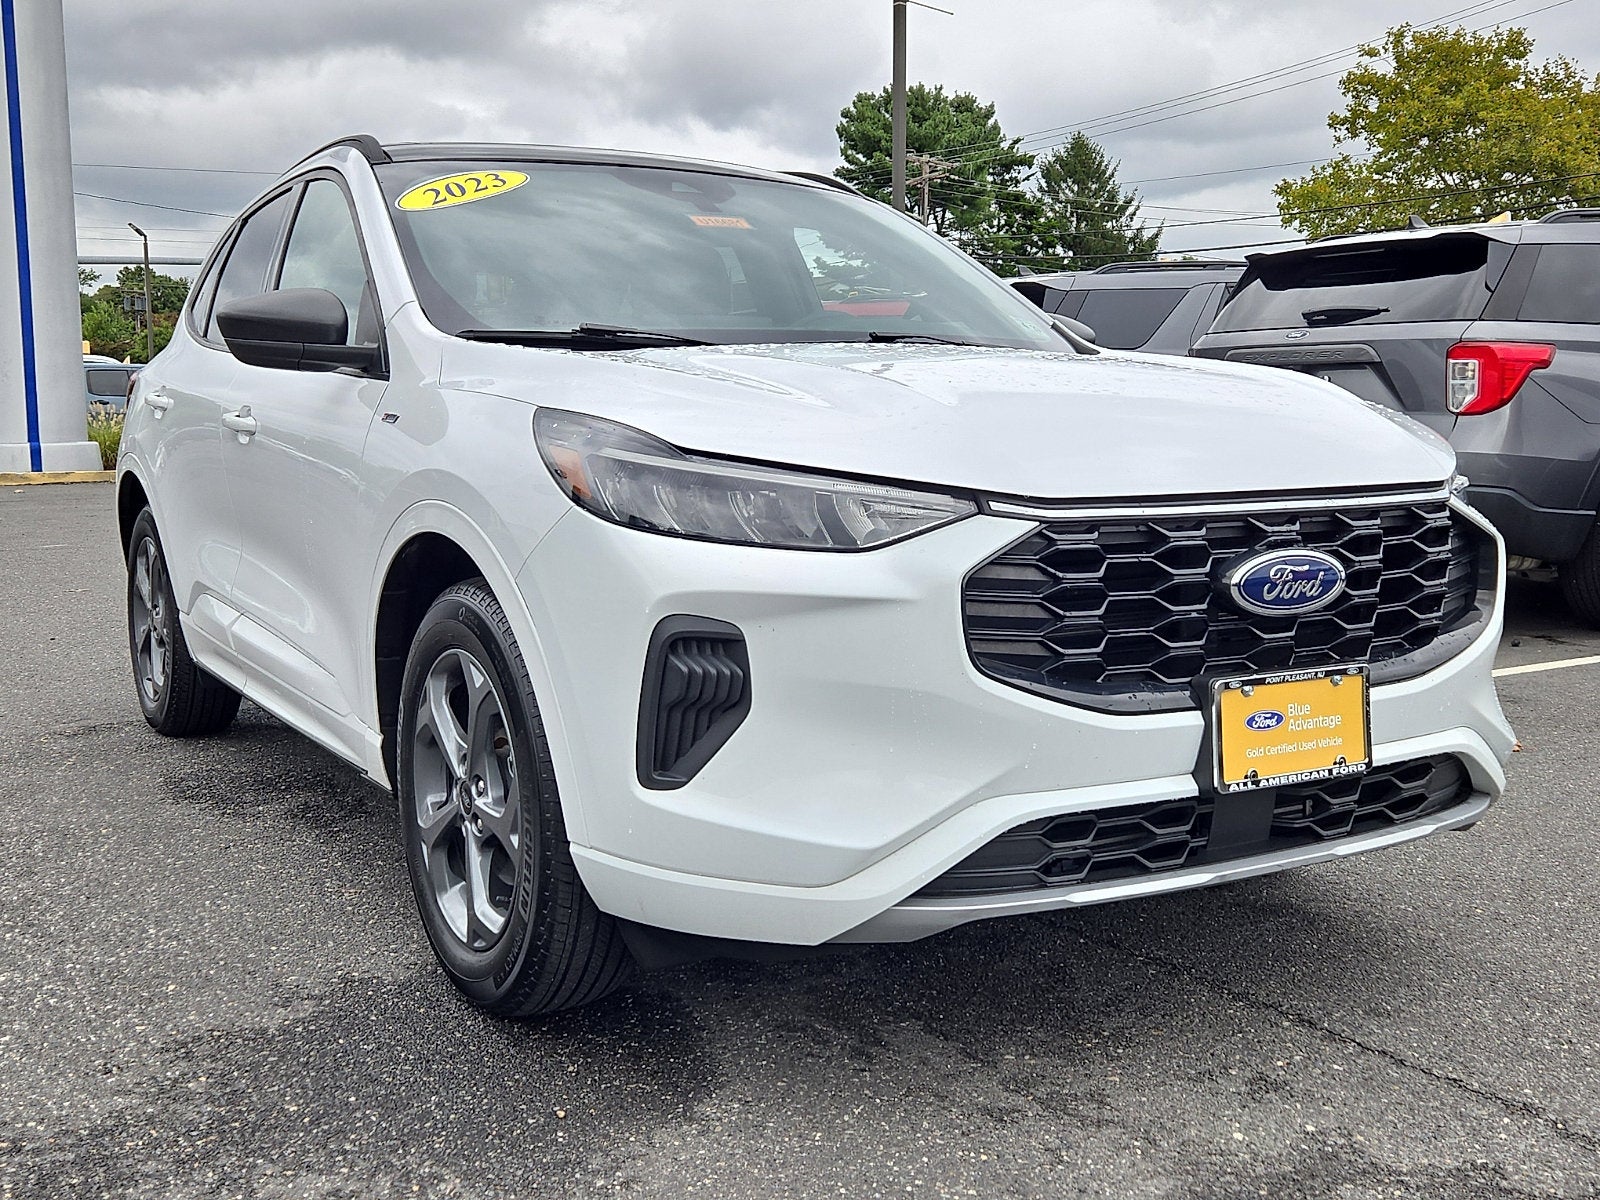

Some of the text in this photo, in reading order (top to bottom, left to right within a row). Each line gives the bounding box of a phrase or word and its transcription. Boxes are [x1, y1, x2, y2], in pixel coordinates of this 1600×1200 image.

[423, 173, 507, 206] 2023
[1243, 350, 1345, 362] EXPLORER
[1262, 564, 1325, 601] Ford
[1265, 676, 1284, 684] POINT
[1287, 703, 1311, 717] Blue
[1252, 713, 1278, 728] Ford
[1288, 714, 1342, 732] Advantage
[1246, 736, 1343, 758] Gold Certified Used Vehicle
[1229, 763, 1367, 792] ALL AMERICAN FORD
[519, 788, 535, 915] MICHELIN
